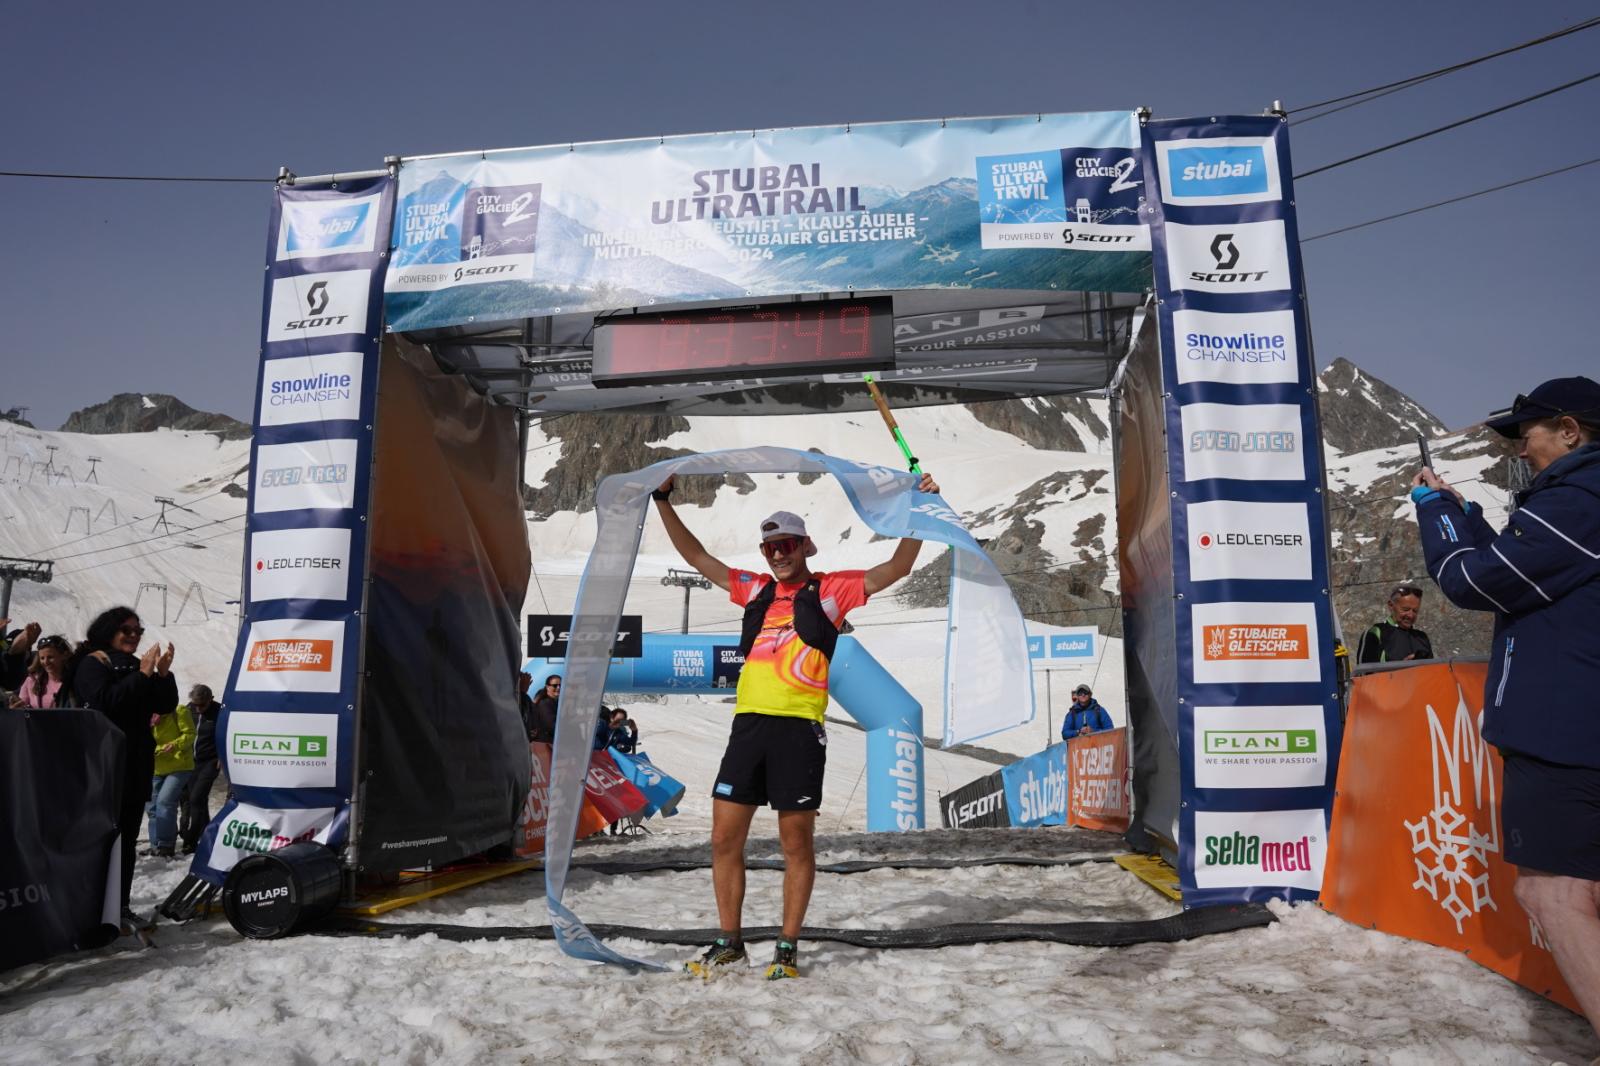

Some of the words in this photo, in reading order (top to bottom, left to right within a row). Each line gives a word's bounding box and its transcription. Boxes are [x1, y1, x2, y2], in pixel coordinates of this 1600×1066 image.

[992, 160, 1043, 174] STUBAI
[1075, 157, 1101, 168] CITY
[1076, 166, 1121, 178] GLACIER
[1182, 160, 1253, 181] stubai
[693, 163, 820, 196] STUBAI
[992, 171, 1048, 187] ULTRA
[477, 195, 501, 205] CITY
[994, 185, 1049, 201] TRAIL
[406, 202, 451, 219] STUBAI
[476, 202, 517, 215] GLACIER
[651, 186, 866, 225] ULTRATRAIL
[405, 213, 451, 232] ULTRA
[798, 215, 855, 231] KLAUS
[860, 211, 916, 228] ÄUELE
[726, 227, 812, 247] STUBAIER
[817, 226, 916, 244] GLETSCHER
[999, 232, 1041, 242] POWERED
[1042, 232, 1054, 240] BY
[1075, 233, 1136, 243] SCOTT
[727, 248, 775, 262] 2024
[398, 273, 438, 284] POWERED
[438, 273, 448, 282] BY
[464, 264, 518, 277] SCOTT
[1189, 271, 1269, 283] SCOTT
[284, 315, 349, 331] SCOTT
[909, 340, 957, 353] YOUR
[964, 324, 1041, 346] PASSION
[1186, 333, 1285, 349] snowline
[1187, 349, 1286, 363] CHAINSEN
[271, 373, 351, 394] snowline
[270, 389, 350, 406] CHAINSEN
[1217, 533, 1303, 546] LEDLENSER
[267, 558, 341, 570] LEDLENSER
[1228, 628, 1287, 640] STUBAIER
[267, 642, 313, 653] STUBAIER
[1056, 640, 1088, 651] stubai
[1229, 640, 1298, 652] GLETSCHER
[267, 653, 323, 665] GLETSCHER
[673, 650, 703, 658] STUBAI
[673, 658, 705, 667] ULTRA
[673, 666, 705, 677] TRAIL
[240, 739, 292, 751] PLAN
[306, 741, 321, 751] B
[1214, 737, 1279, 748] PLAN
[1296, 736, 1310, 747] B
[244, 758, 265, 766] SHARE
[267, 759, 288, 767] YOUR
[1280, 757, 1318, 765] PASSION
[888, 728, 917, 831] stubai
[1019, 753, 1067, 823] stubai
[959, 789, 1004, 824] SCOTT
[381, 835, 448, 850] #weshareyourpassion
[241, 887, 288, 904] MYLAPS
